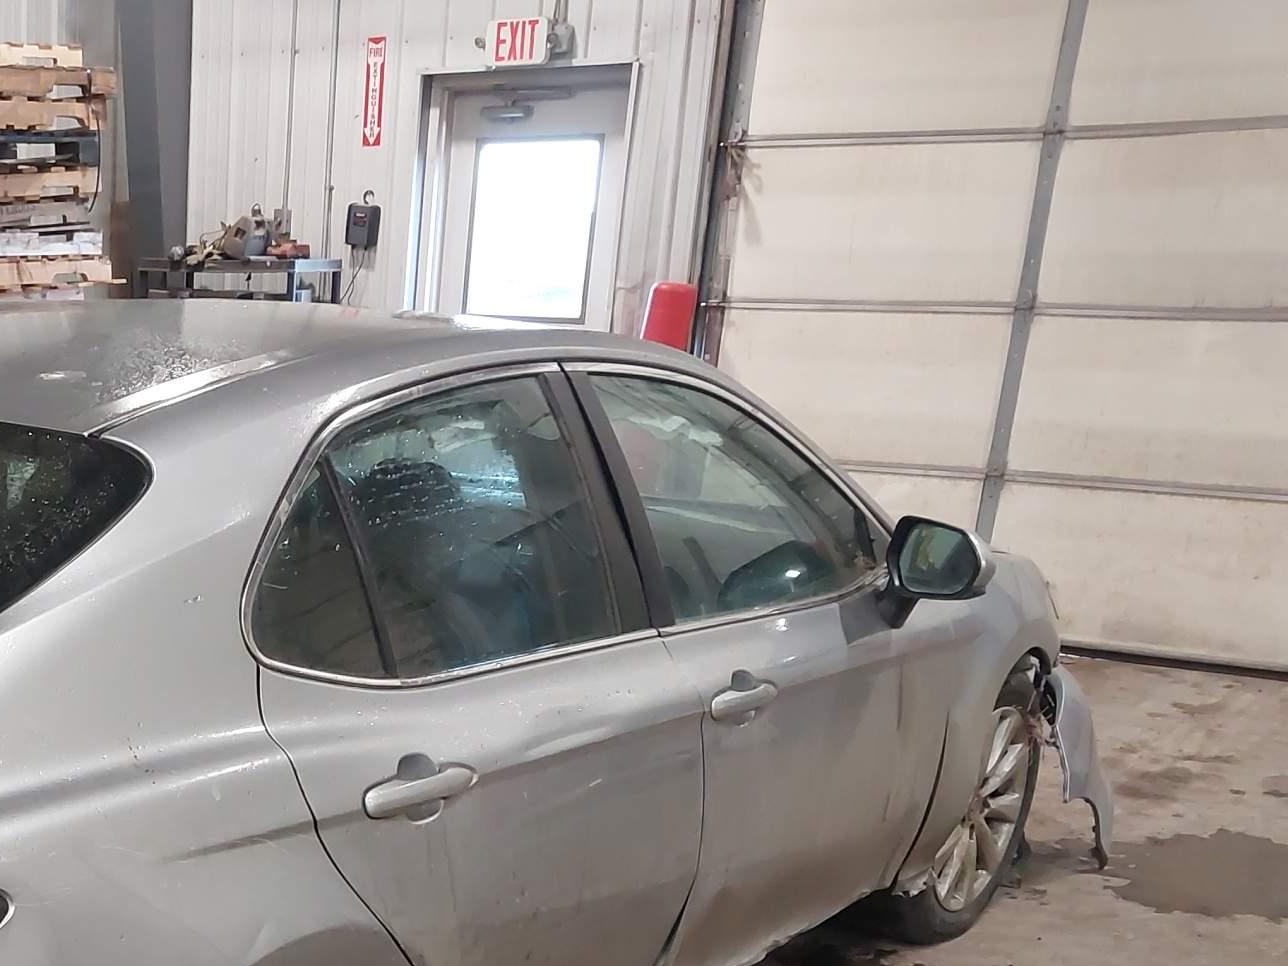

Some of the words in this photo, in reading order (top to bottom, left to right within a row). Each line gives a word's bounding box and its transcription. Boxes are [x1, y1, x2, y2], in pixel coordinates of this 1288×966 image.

[369, 47, 383, 58] FIRE
[495, 19, 539, 62] EXIT
[369, 62, 378, 138] EXTINGUISHER
